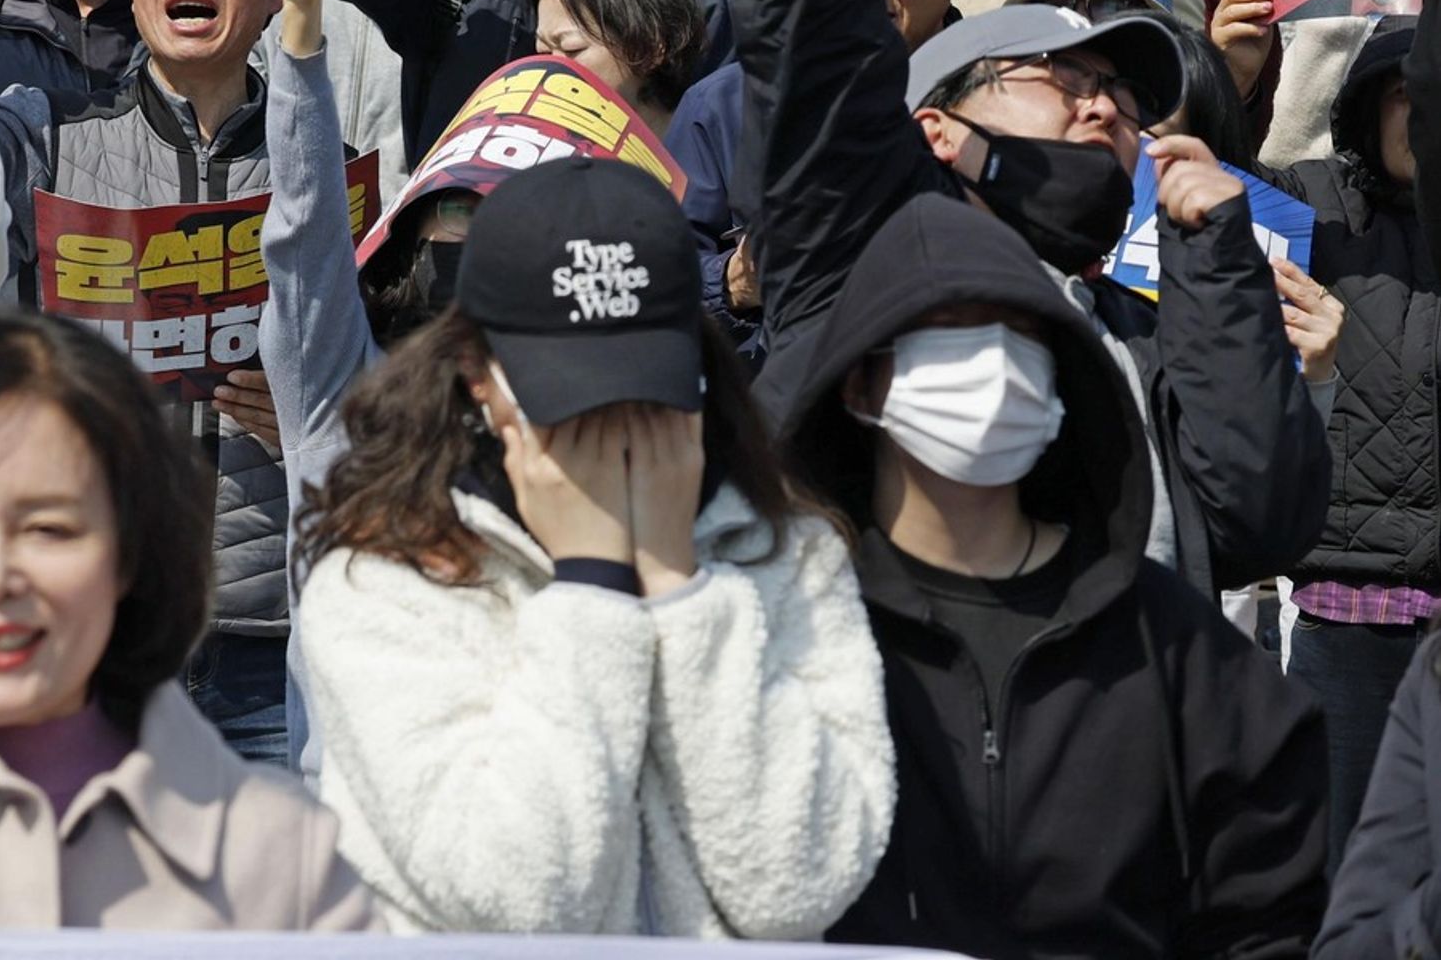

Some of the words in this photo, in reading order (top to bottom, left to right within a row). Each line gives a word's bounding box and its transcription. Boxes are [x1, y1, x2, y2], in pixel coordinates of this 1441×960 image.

[445, 69, 673, 190] 석열을
[565, 239, 636, 273] Type
[552, 262, 651, 298] Service
[568, 288, 641, 323] .Web
